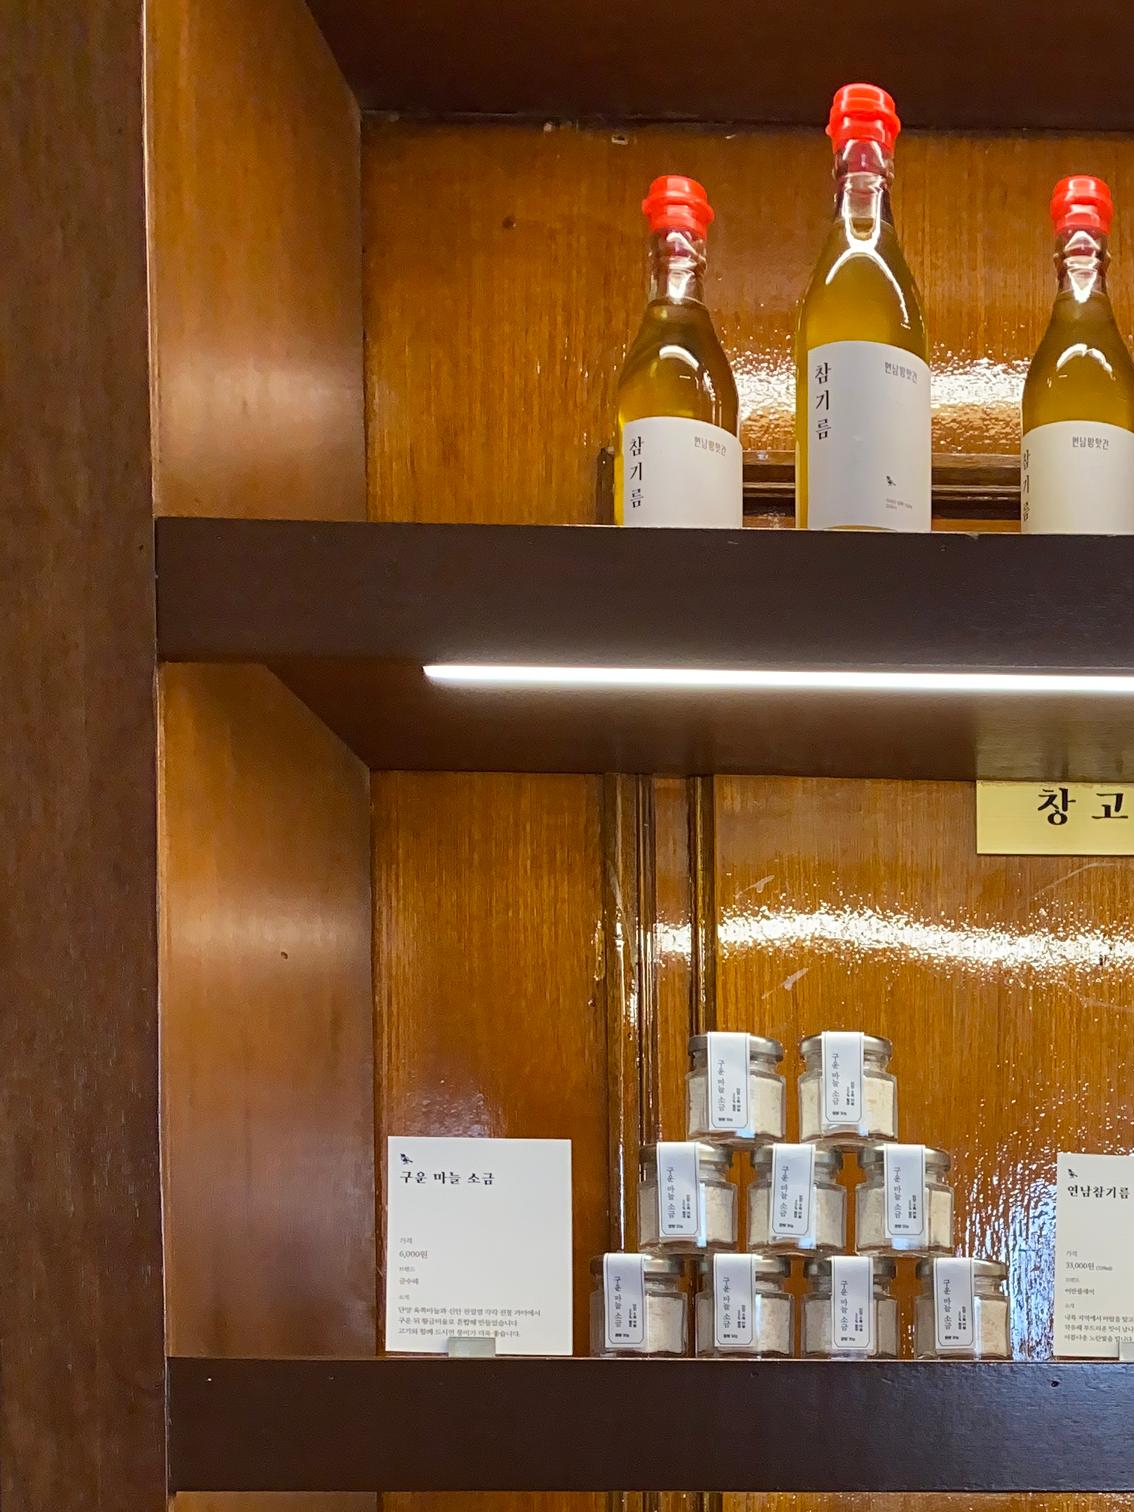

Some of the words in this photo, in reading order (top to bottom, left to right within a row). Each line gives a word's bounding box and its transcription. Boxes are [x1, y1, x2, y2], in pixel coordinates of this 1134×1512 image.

[815, 362, 832, 440] 참기름
[630, 436, 644, 508] 참기름
[400, 1171, 427, 1185] 구운
[433, 1171, 461, 1185] 마늘
[467, 1172, 495, 1186] 소금
[1067, 1185, 1130, 1200] 연남참기름
